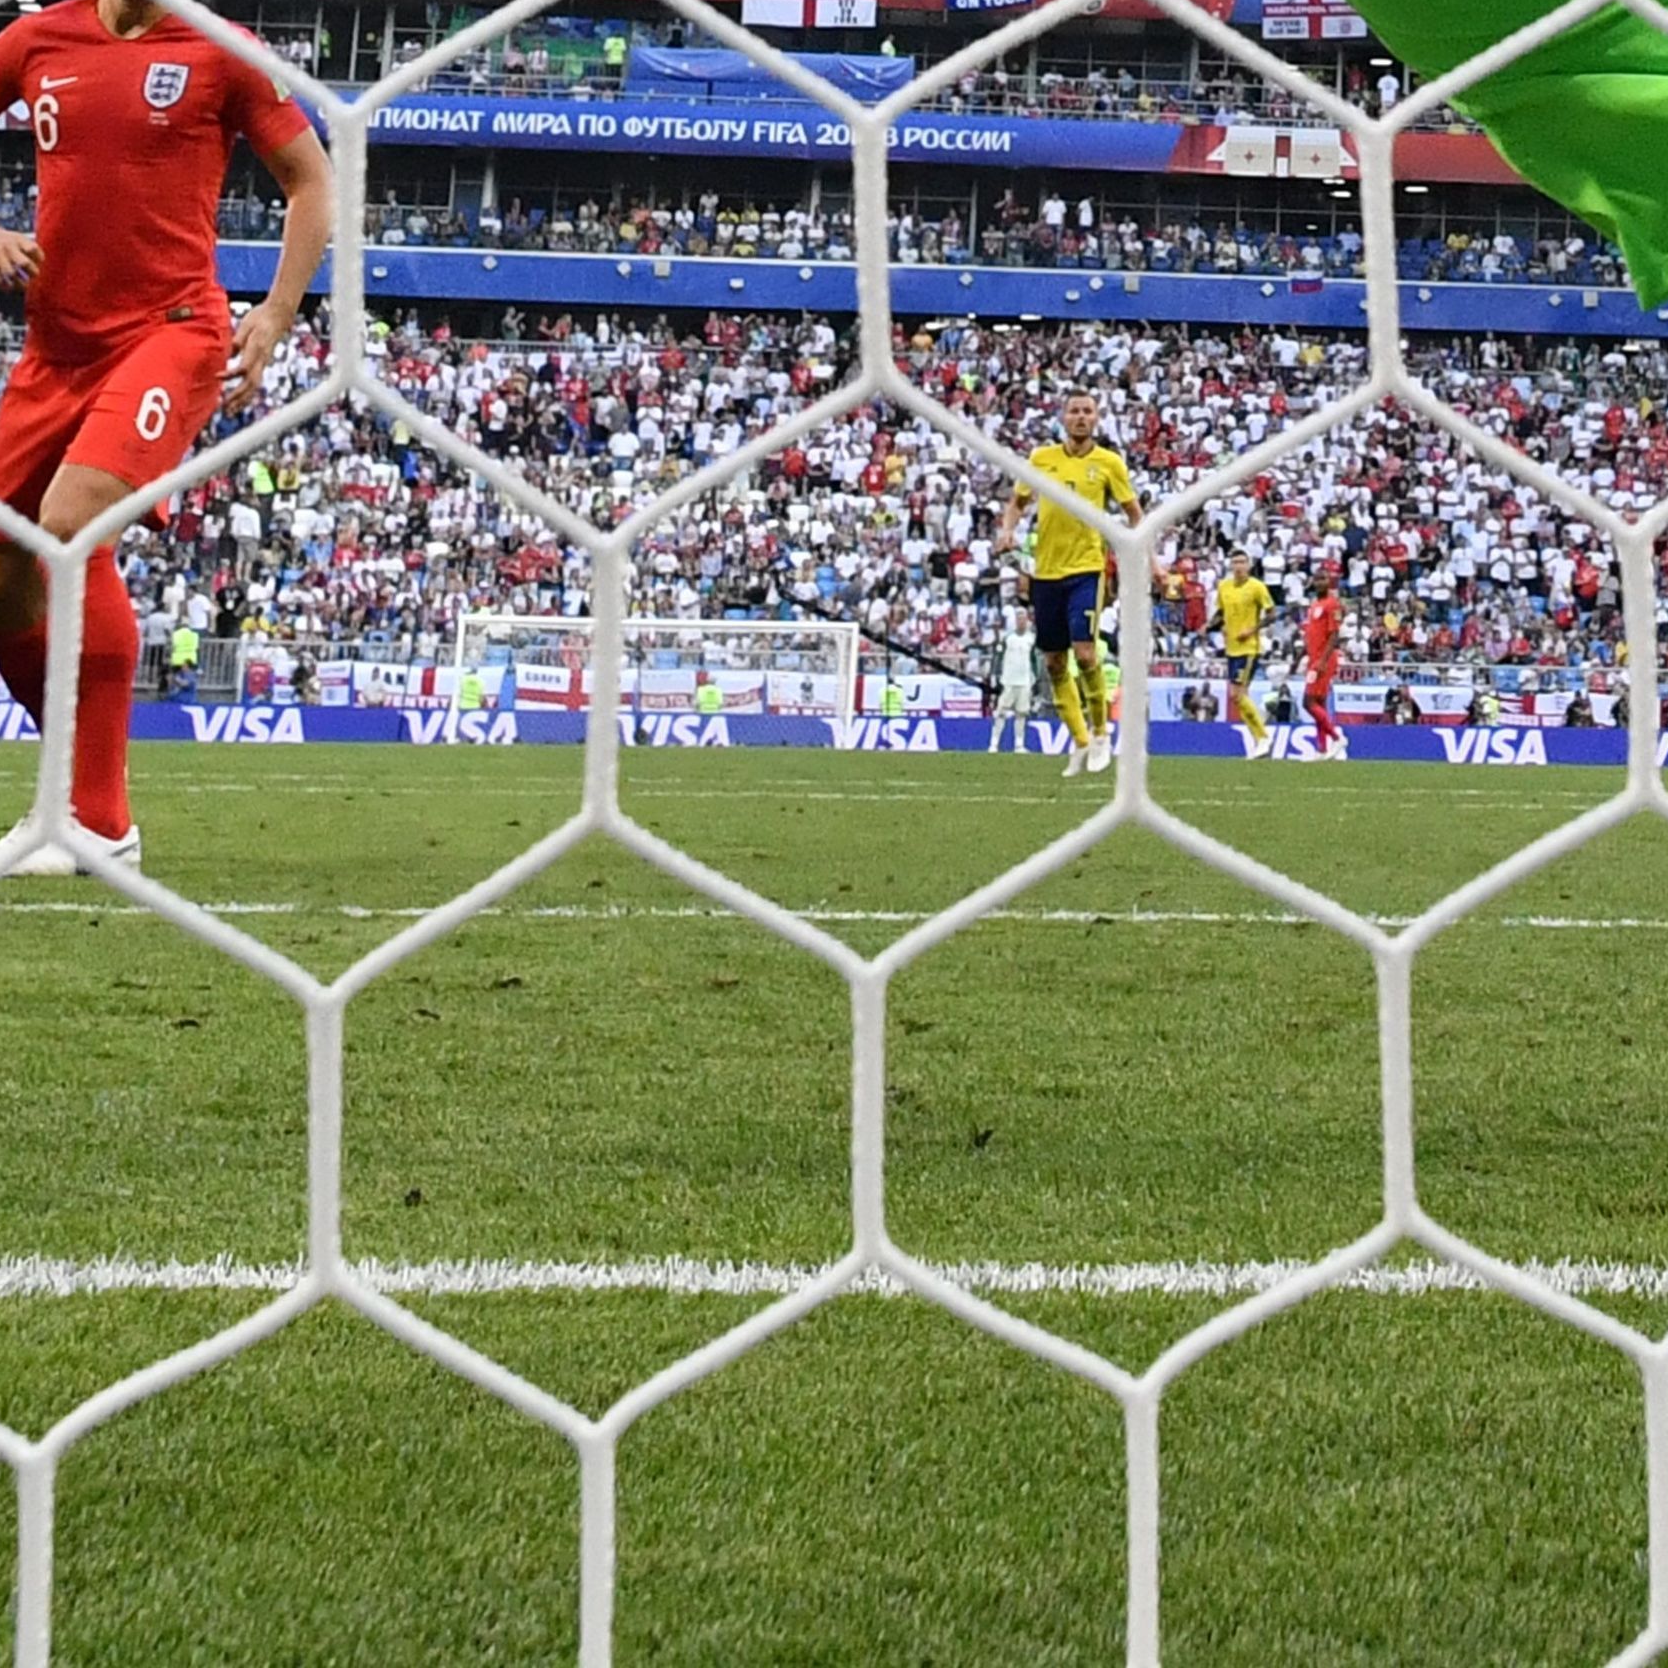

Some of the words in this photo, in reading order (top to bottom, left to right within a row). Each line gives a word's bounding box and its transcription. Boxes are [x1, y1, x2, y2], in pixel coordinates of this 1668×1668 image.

[33, 93, 60, 152] 6
[492, 111, 572, 136] МИРА
[577, 113, 617, 137] ПО
[623, 115, 748, 142] ФУТБОЛУ
[752, 120, 808, 145] FIFA
[903, 126, 1012, 152] РОССИИ
[135, 386, 171, 441] 6
[181, 704, 305, 744] VISA
[821, 717, 940, 751] VISA
[1432, 727, 1548, 766] VISA
